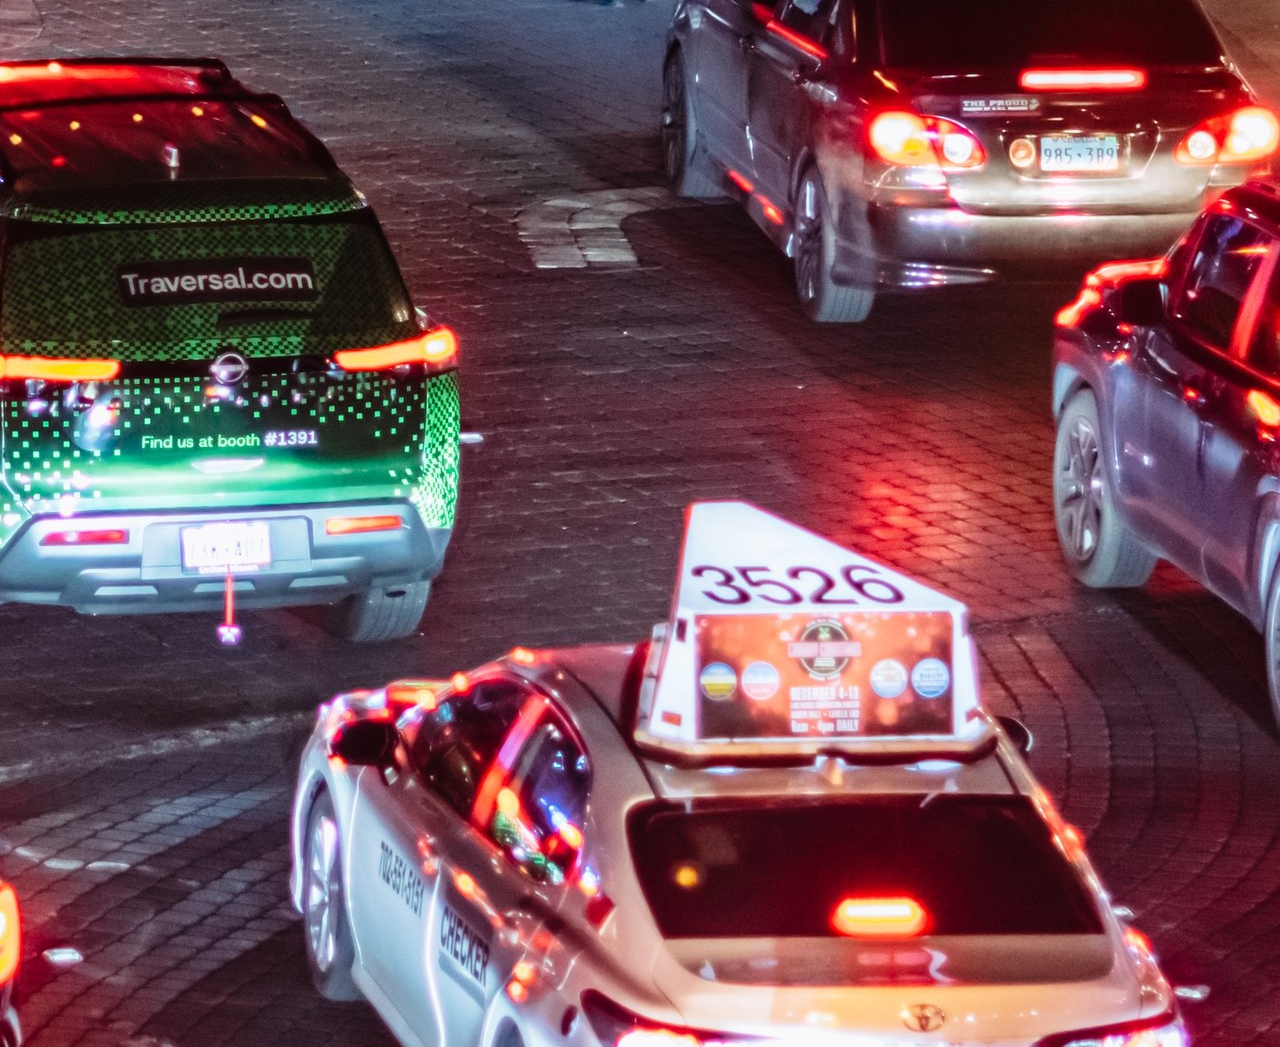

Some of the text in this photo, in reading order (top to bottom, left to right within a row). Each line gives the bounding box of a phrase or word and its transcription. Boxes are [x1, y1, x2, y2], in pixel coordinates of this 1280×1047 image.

[121, 267, 314, 295] Traversal.com
[141, 430, 318, 449] Find us at booth #1391
[691, 564, 905, 605] 3526
[378, 841, 425, 918] 702-551-5151
[441, 904, 490, 988] CHECKER
